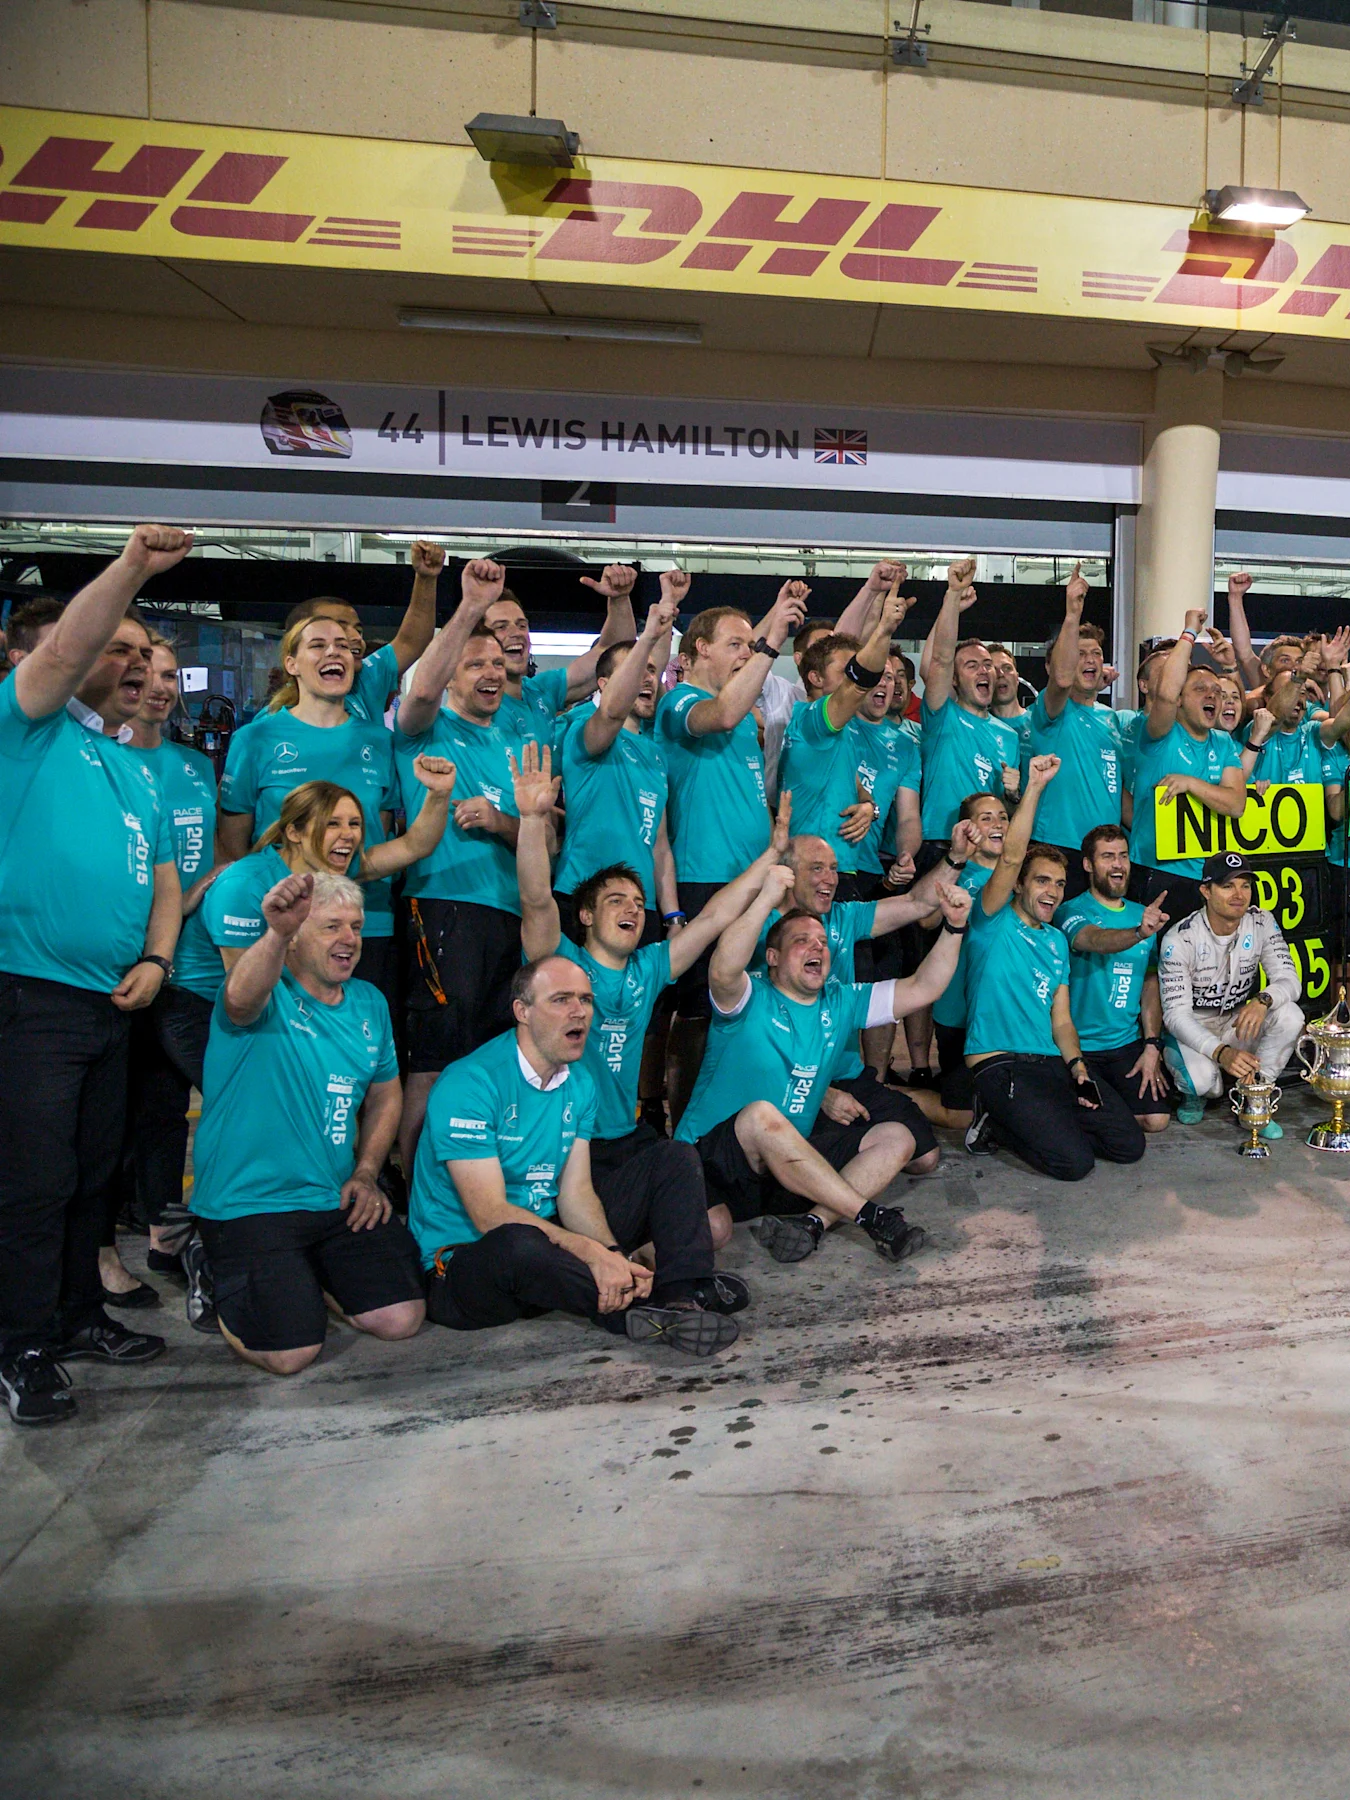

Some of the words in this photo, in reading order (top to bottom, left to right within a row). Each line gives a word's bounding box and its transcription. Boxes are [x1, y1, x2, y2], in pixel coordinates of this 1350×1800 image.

[0, 137, 317, 243] HL
[533, 177, 965, 286] DHL
[378, 412, 424, 443] 44
[462, 414, 586, 451] LEWIS
[602, 421, 799, 461] HAMILTON
[1108, 763, 1117, 793] 2015
[173, 807, 203, 818] RACE
[1176, 787, 1307, 854] NICO
[135, 832, 150, 885] 2015
[183, 827, 203, 872] 2015
[1254, 867, 1305, 930] P3
[1115, 976, 1131, 1008] 2015
[1162, 985, 1185, 994] EPSON
[329, 1073, 357, 1085] RACE
[789, 1079, 813, 1114] 2015
[332, 1096, 352, 1145] 2015
[527, 1163, 555, 1172] RACE
